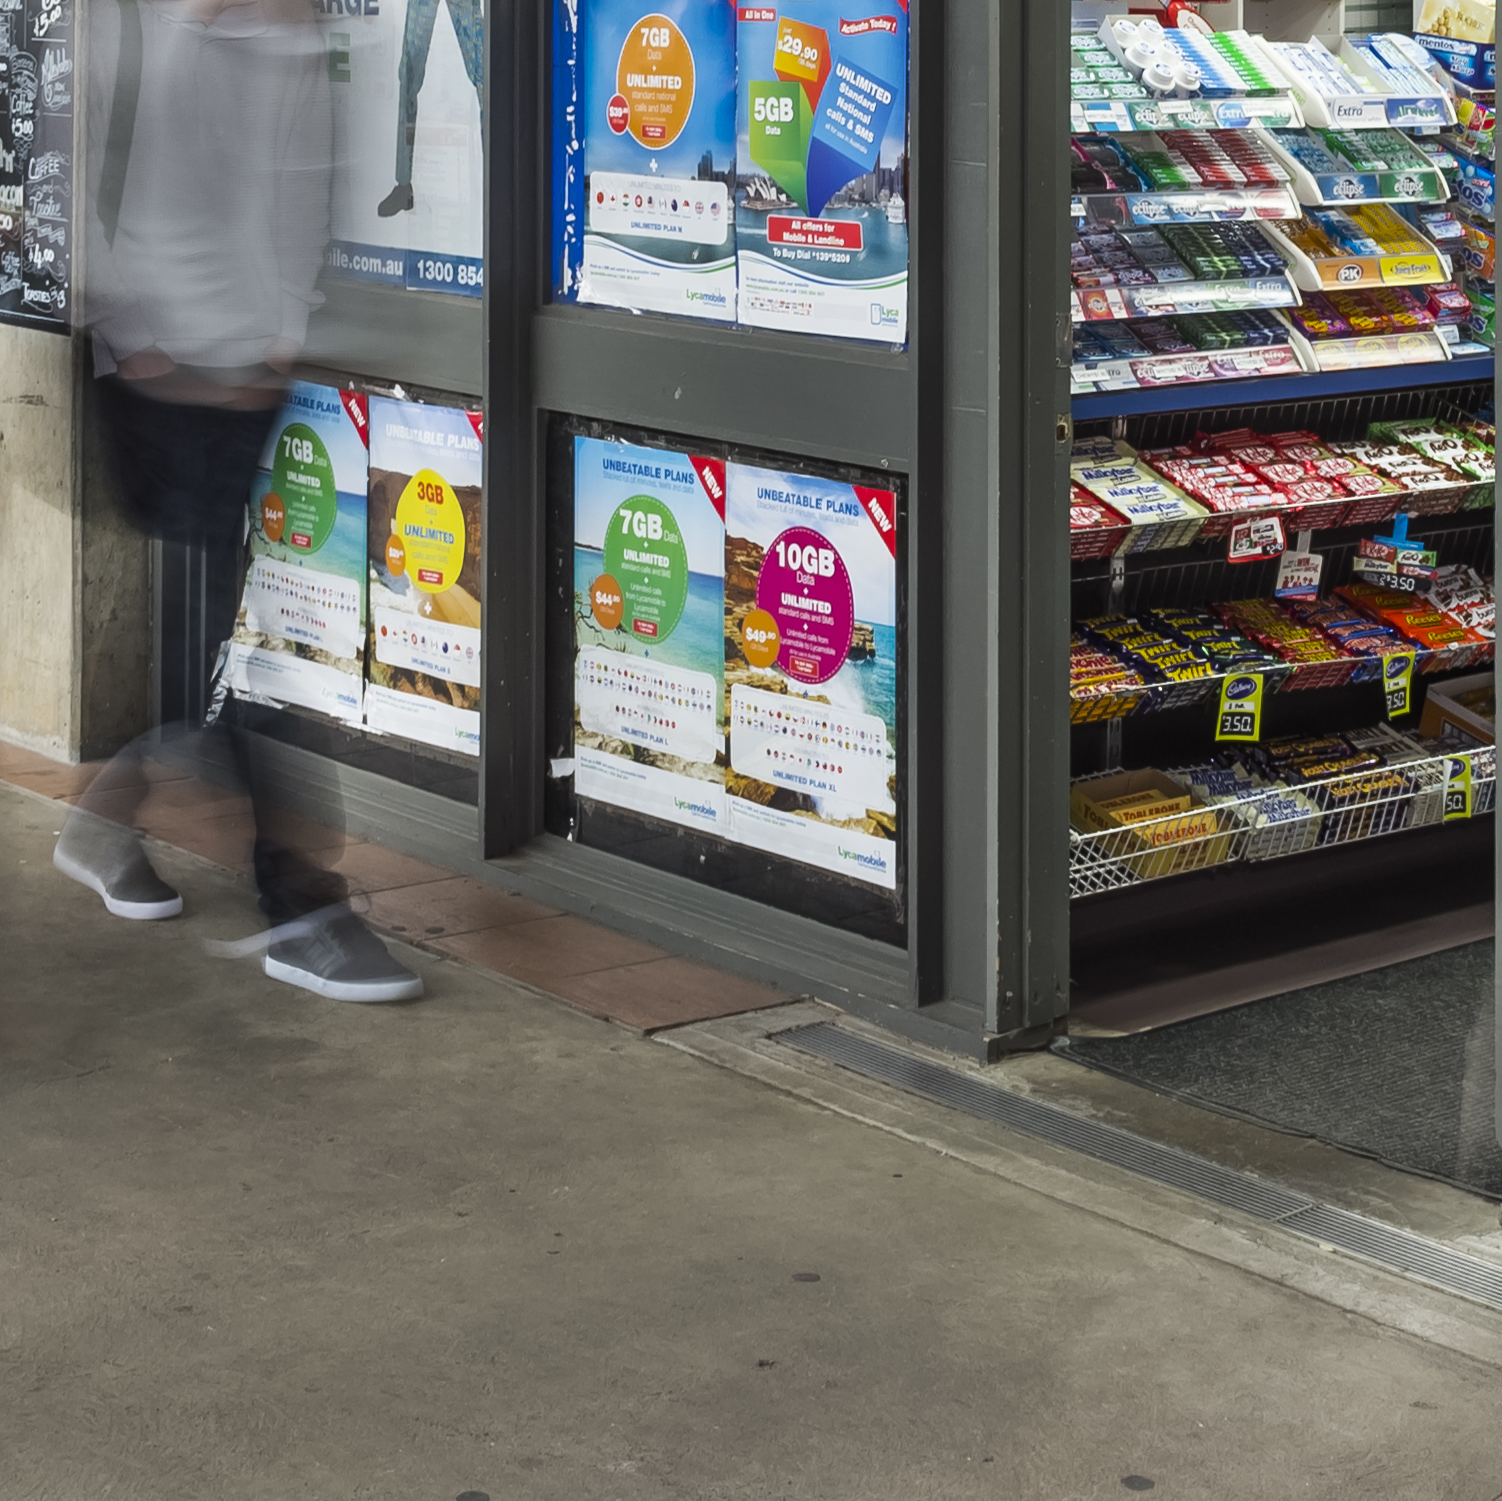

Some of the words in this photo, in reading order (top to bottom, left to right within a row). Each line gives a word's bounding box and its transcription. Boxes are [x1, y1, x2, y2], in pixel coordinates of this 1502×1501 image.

[640, 27, 670, 47] 7GB
[1419, 39, 1454, 49] mentos
[627, 74, 682, 89] UNLIMITED
[835, 63, 892, 105] UNLIMITED
[839, 82, 877, 112] Standard
[753, 96, 794, 123] 5GB
[836, 96, 872, 126] National
[1337, 105, 1363, 116] Extra
[765, 125, 781, 136] Data
[826, 108, 846, 126] calls
[855, 124, 874, 144] SMS
[1333, 180, 1364, 195] eclipse
[1394, 179, 1423, 193] eclipse
[417, 260, 455, 284] 1300
[686, 289, 726, 304] Lycamobile
[348, 398, 366, 428] NEW
[283, 435, 314, 464] 7GB
[447, 427, 479, 450] PLANS
[602, 458, 662, 480] UNBEATABLE
[664, 470, 694, 485] PLANS
[702, 466, 723, 499] NEW
[1083, 468, 1135, 481] Milkybar
[417, 481, 444, 505] 3GB
[757, 487, 823, 510] UNBEATABLE
[826, 499, 859, 517] PLANS
[1107, 485, 1160, 497] Milkybar
[868, 497, 892, 533] NEW
[1127, 501, 1182, 515] Milkybar
[404, 523, 455, 545] UNLIMITED
[619, 508, 663, 540] 7GB
[623, 548, 670, 568] UNLIMITED
[776, 540, 835, 578] 10GB
[796, 571, 815, 587] Data
[781, 592, 832, 614] UNLIMITED
[772, 769, 808, 787] UNLIMITED
[809, 778, 827, 791] PLAN
[674, 796, 716, 819] Lycamobile
[1123, 802, 1180, 822] TOBLERONE
[838, 845, 887, 869] Lycamobile
